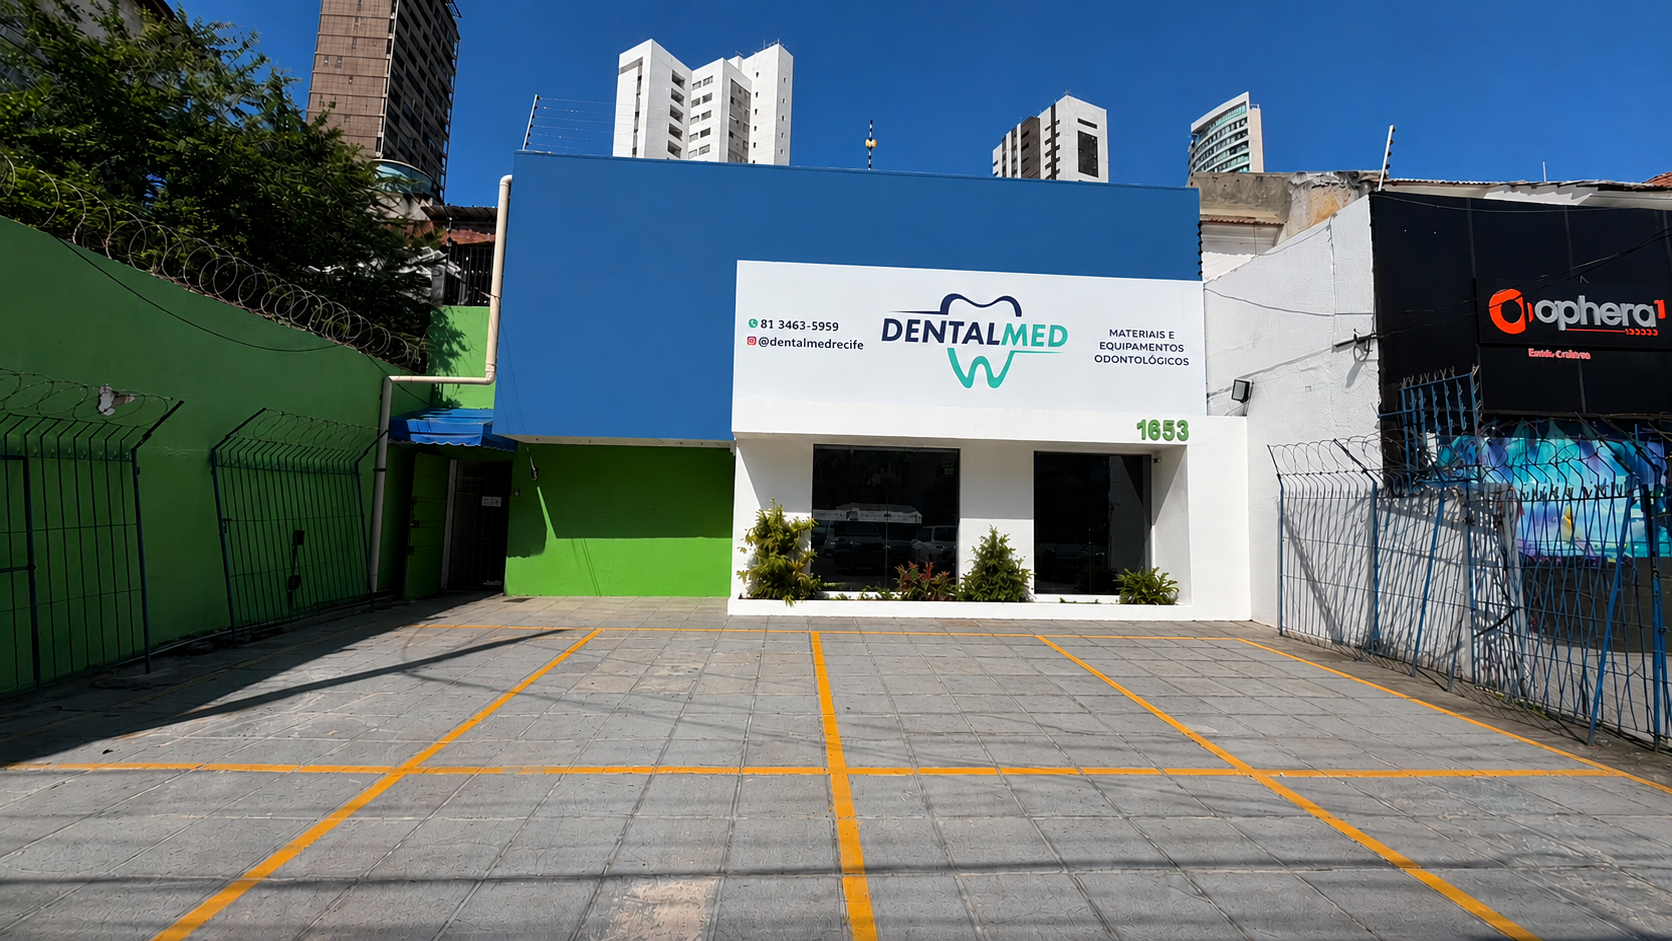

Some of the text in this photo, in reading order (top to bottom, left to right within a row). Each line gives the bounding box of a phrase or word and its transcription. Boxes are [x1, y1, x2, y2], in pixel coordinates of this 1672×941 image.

[760, 319, 839, 332] 81 3463-5959
[881, 318, 1068, 347] DENTALMED
[1109, 329, 1175, 340] MATERIAIS E
[758, 336, 864, 350] @dentalmedrecife
[1099, 341, 1185, 352] EQUIPAMENTOS
[1094, 354, 1190, 366] ODONTOLÓGICOS
[1136, 419, 1190, 441] 1653
